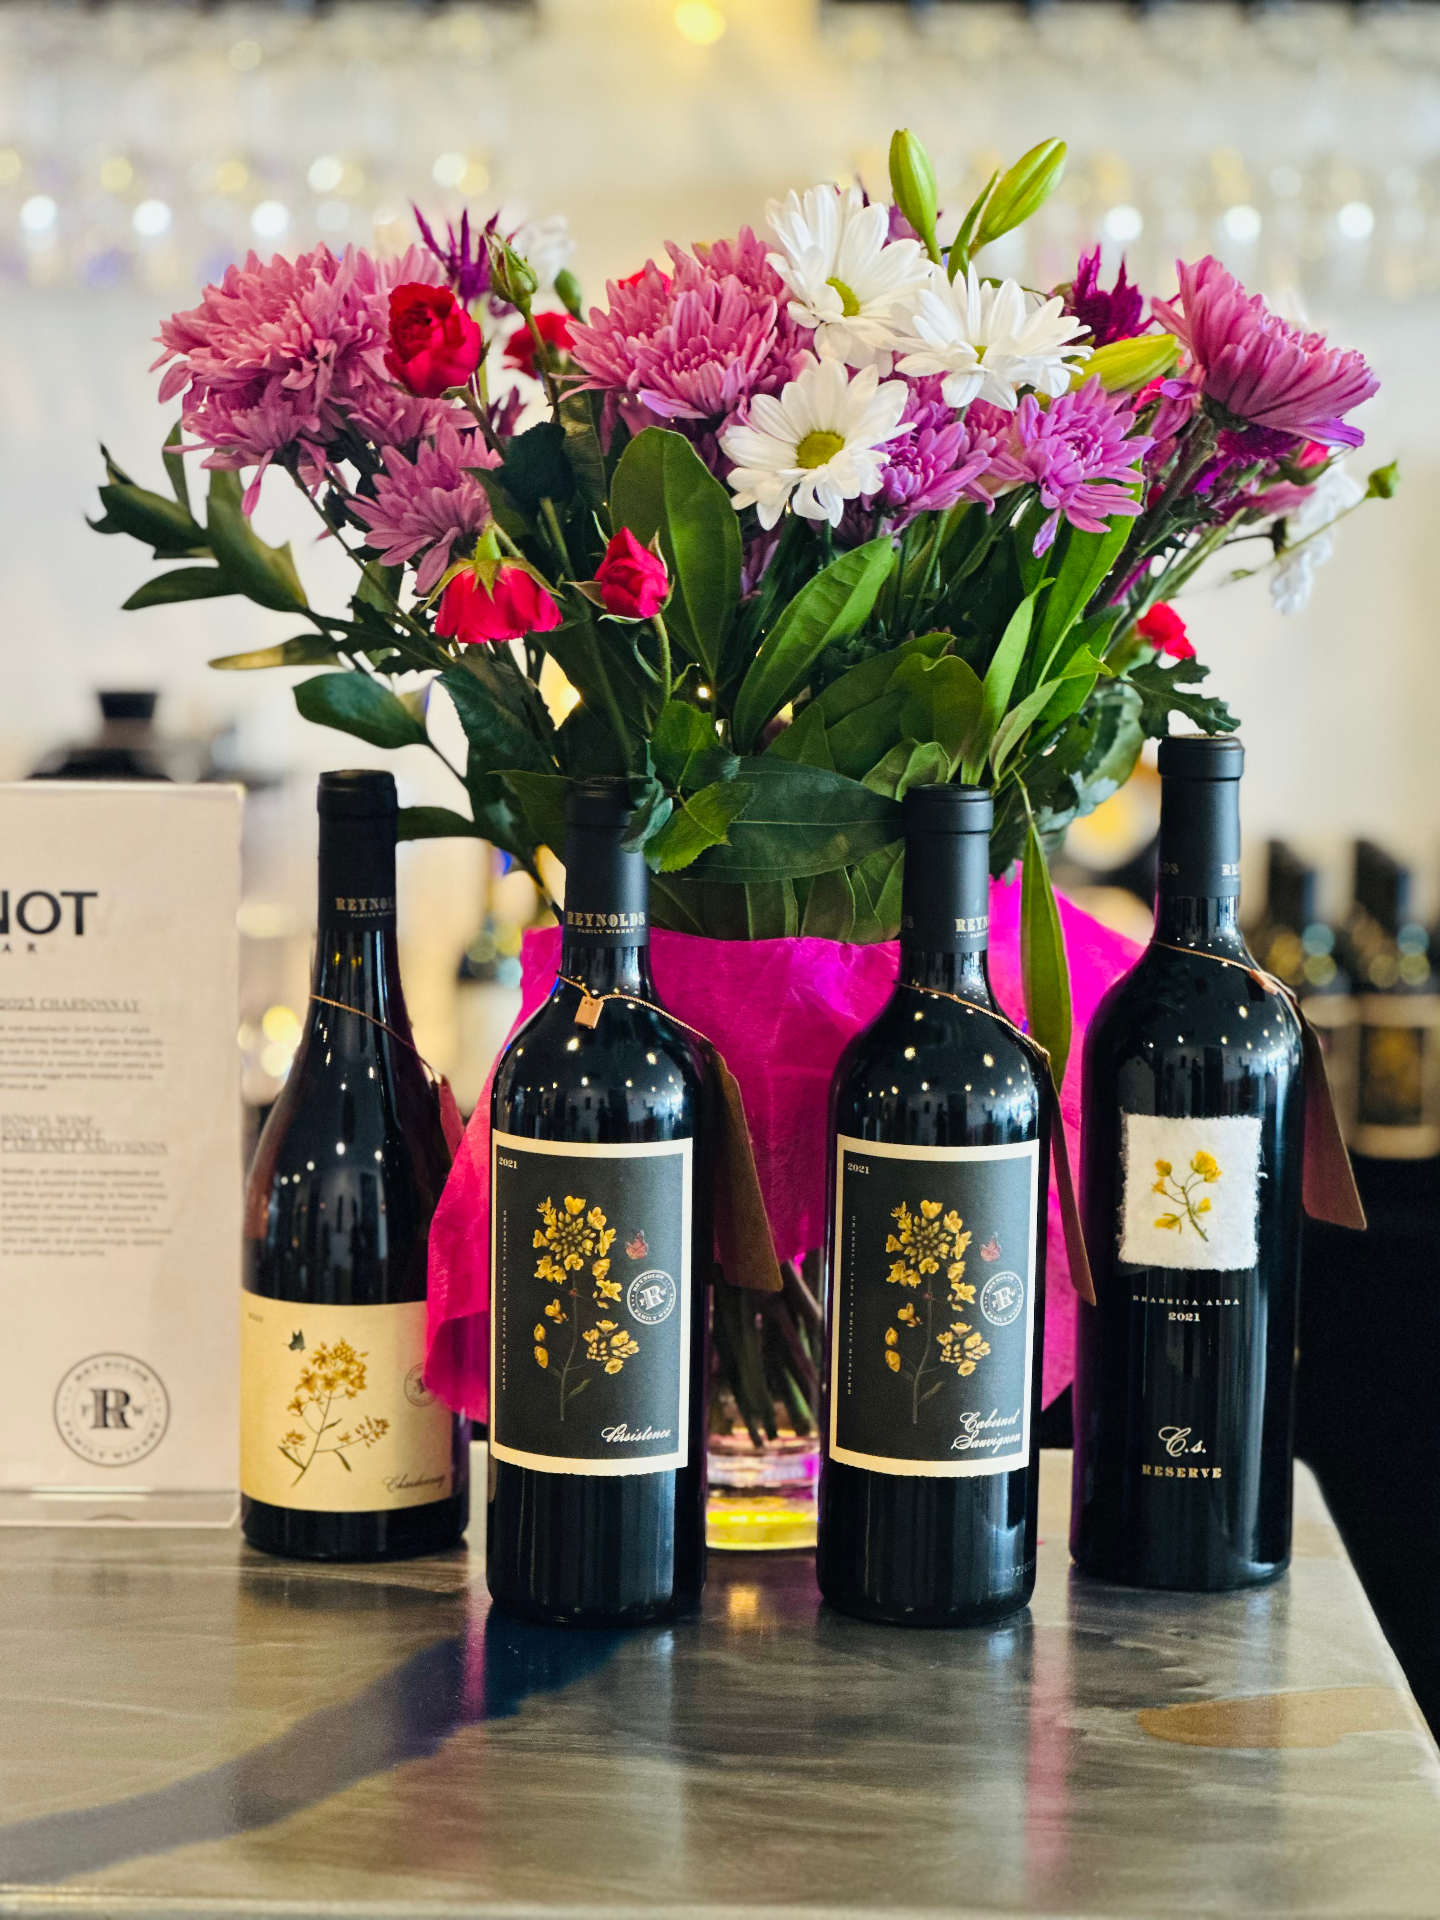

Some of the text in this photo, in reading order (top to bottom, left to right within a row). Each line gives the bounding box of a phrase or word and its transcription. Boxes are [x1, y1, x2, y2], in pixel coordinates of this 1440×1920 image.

[0, 891, 98, 935] OT
[566, 911, 646, 927] REYNOLDS
[498, 1156, 518, 1170] 2021
[847, 1162, 870, 1175] 2021
[1132, 1294, 1240, 1306] BRASSICA ALBA
[634, 1308, 658, 1321] FAMILY
[1168, 1311, 1201, 1322] 2021
[960, 1408, 1020, 1433] Cabernet
[601, 1423, 672, 1443] Persistence
[950, 1429, 1021, 1455] Sauvignon
[1142, 1464, 1223, 1479] RESERVE
[382, 1473, 447, 1493] Chardonnay
